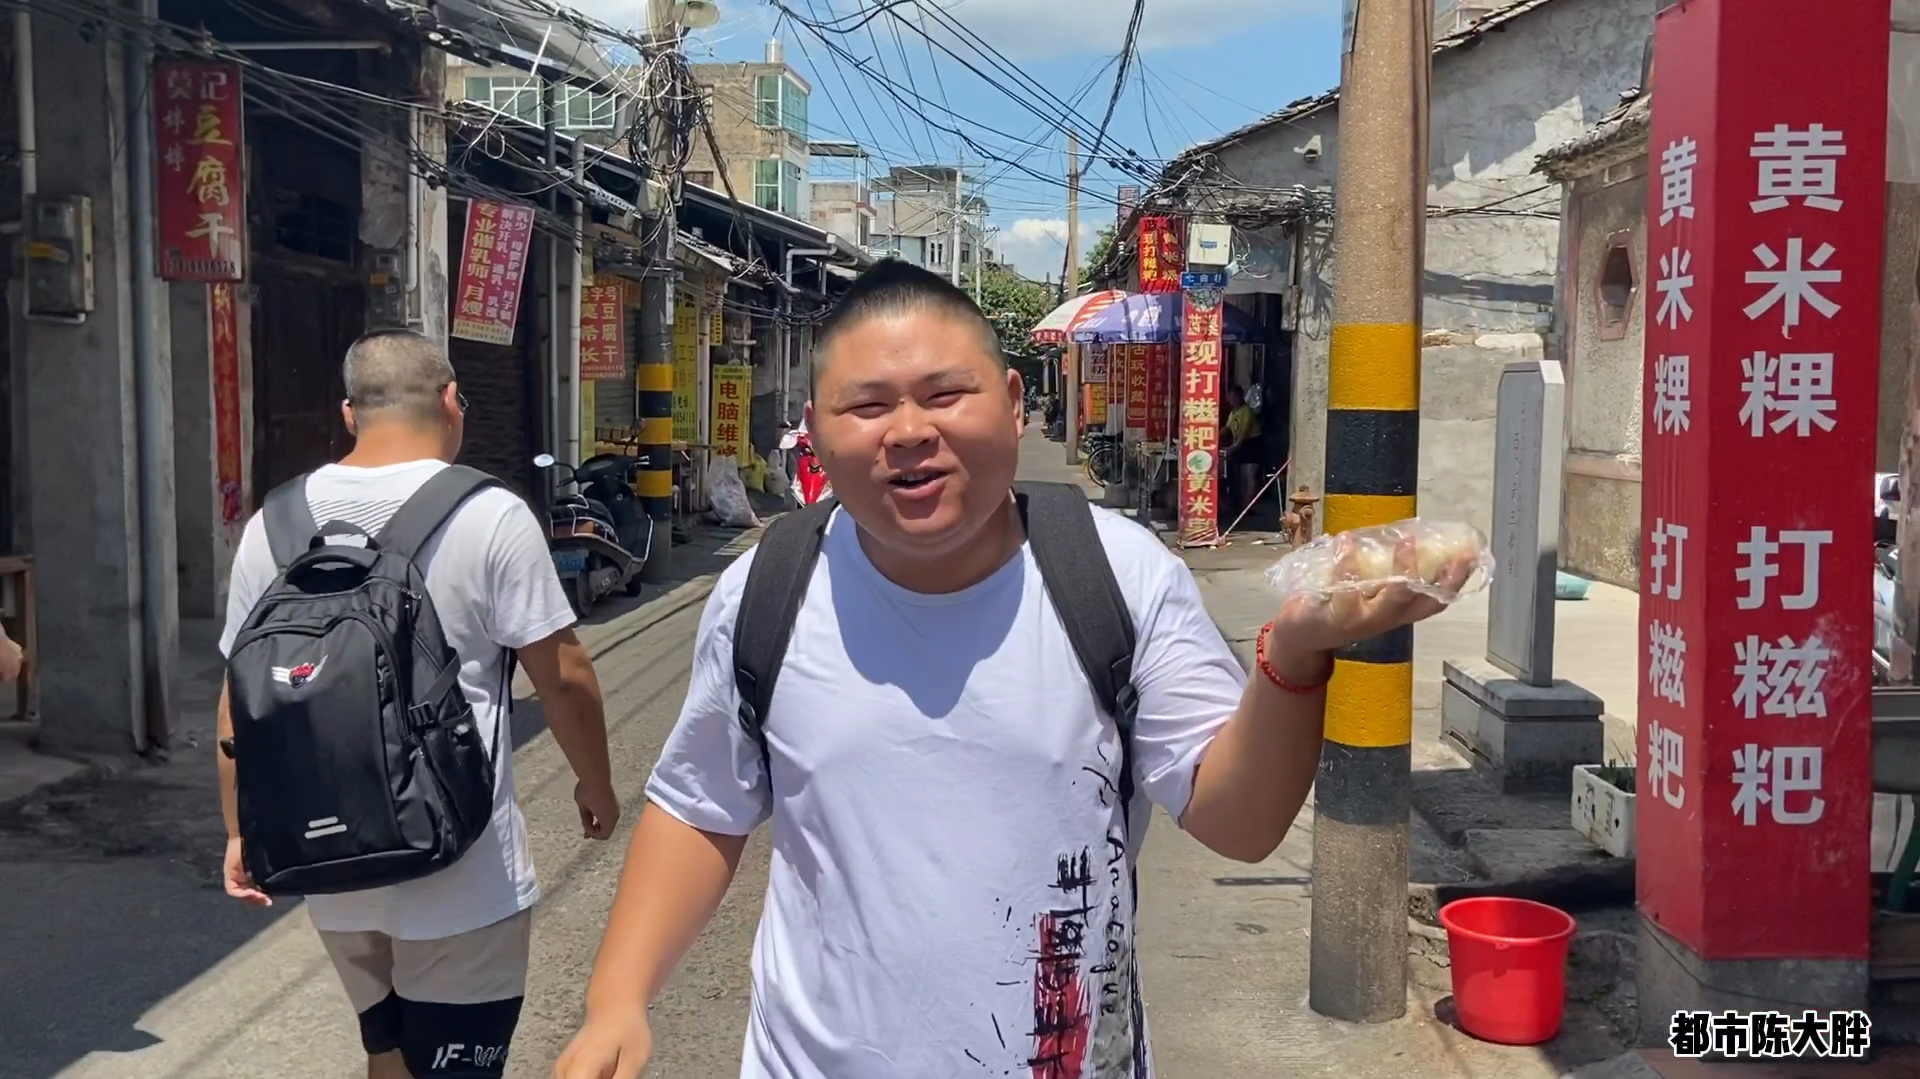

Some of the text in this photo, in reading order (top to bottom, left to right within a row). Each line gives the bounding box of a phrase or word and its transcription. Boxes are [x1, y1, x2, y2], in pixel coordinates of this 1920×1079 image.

[185, 104, 234, 259] 豆腐干
[601, 303, 618, 364] 豆腐干
[1182, 340, 1219, 450] 现打糍粑
[1648, 136, 1697, 810] 黄米粿 打糍粑
[1731, 123, 1847, 826] 黄米粿 打糍粑
